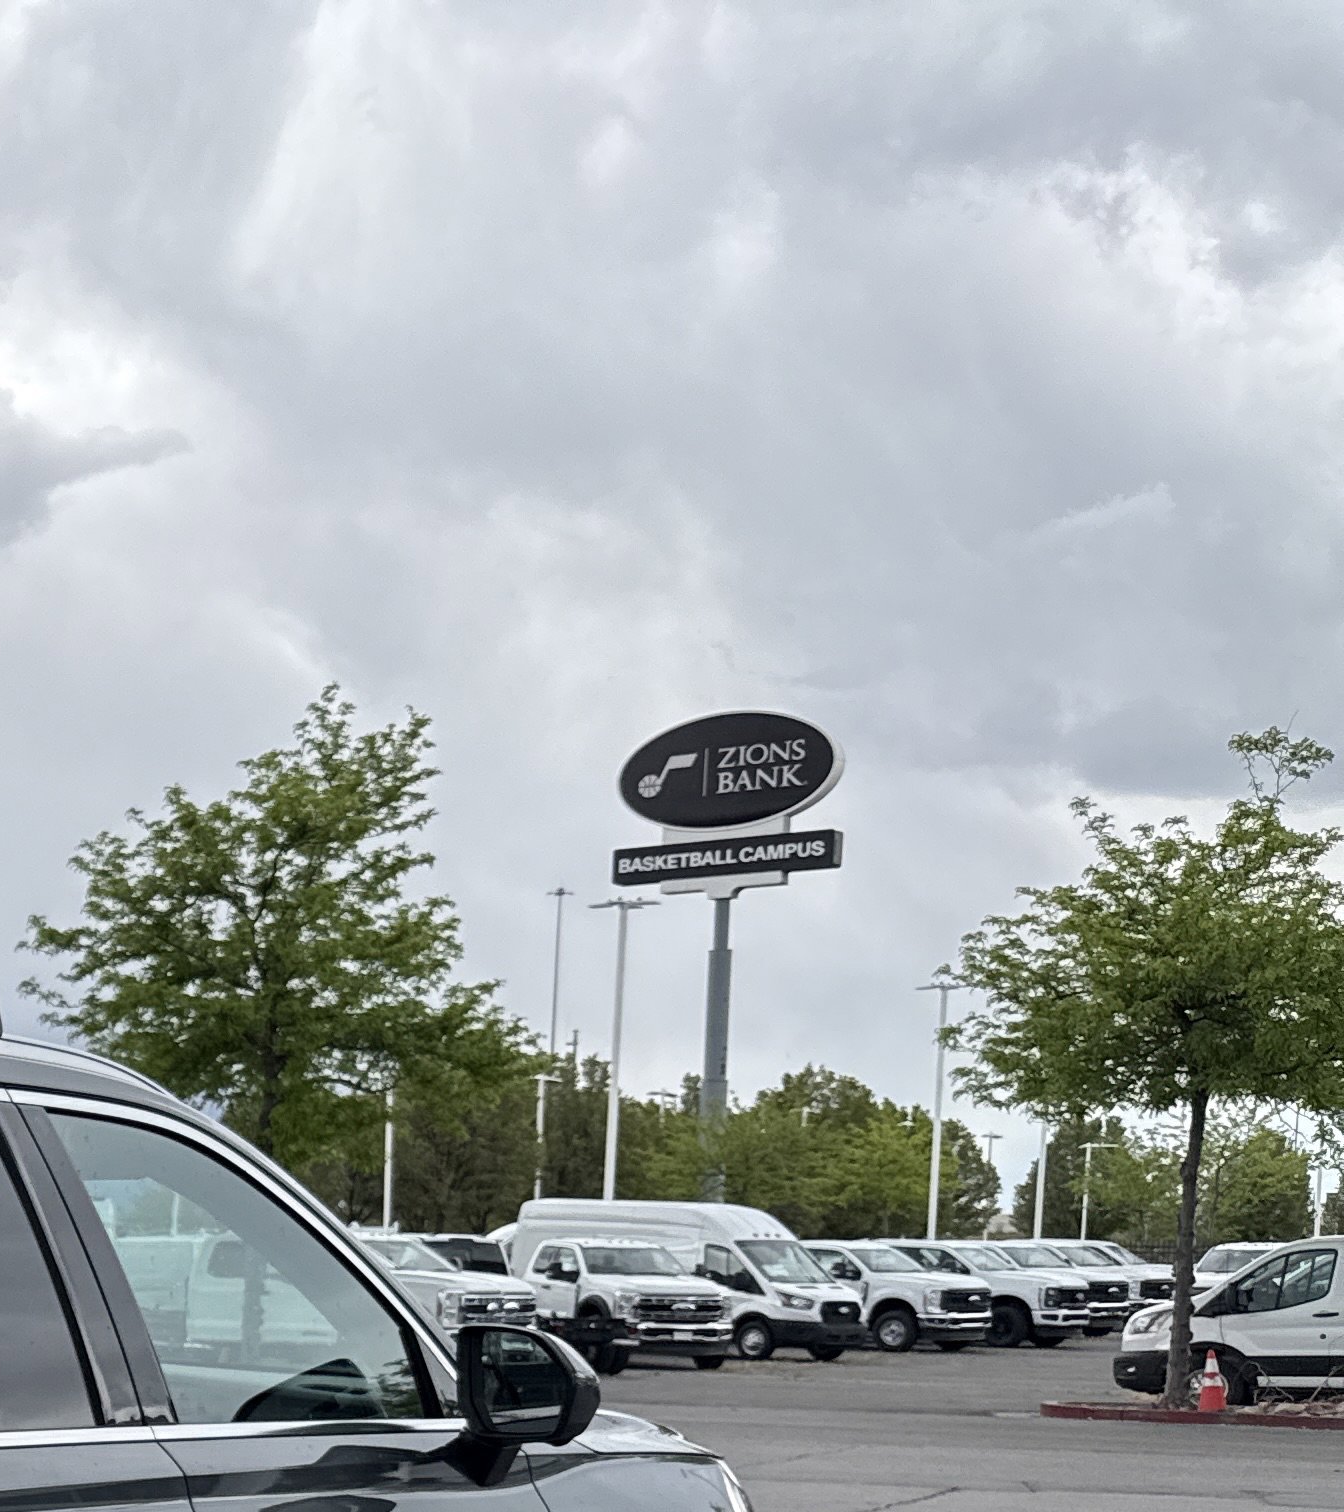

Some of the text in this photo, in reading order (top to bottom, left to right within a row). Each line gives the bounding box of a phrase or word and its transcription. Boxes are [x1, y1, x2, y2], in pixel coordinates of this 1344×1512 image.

[716, 738, 807, 769] ZIONS
[715, 764, 808, 795] BANK
[617, 840, 826, 874] BASKETBALL CAMPUS
